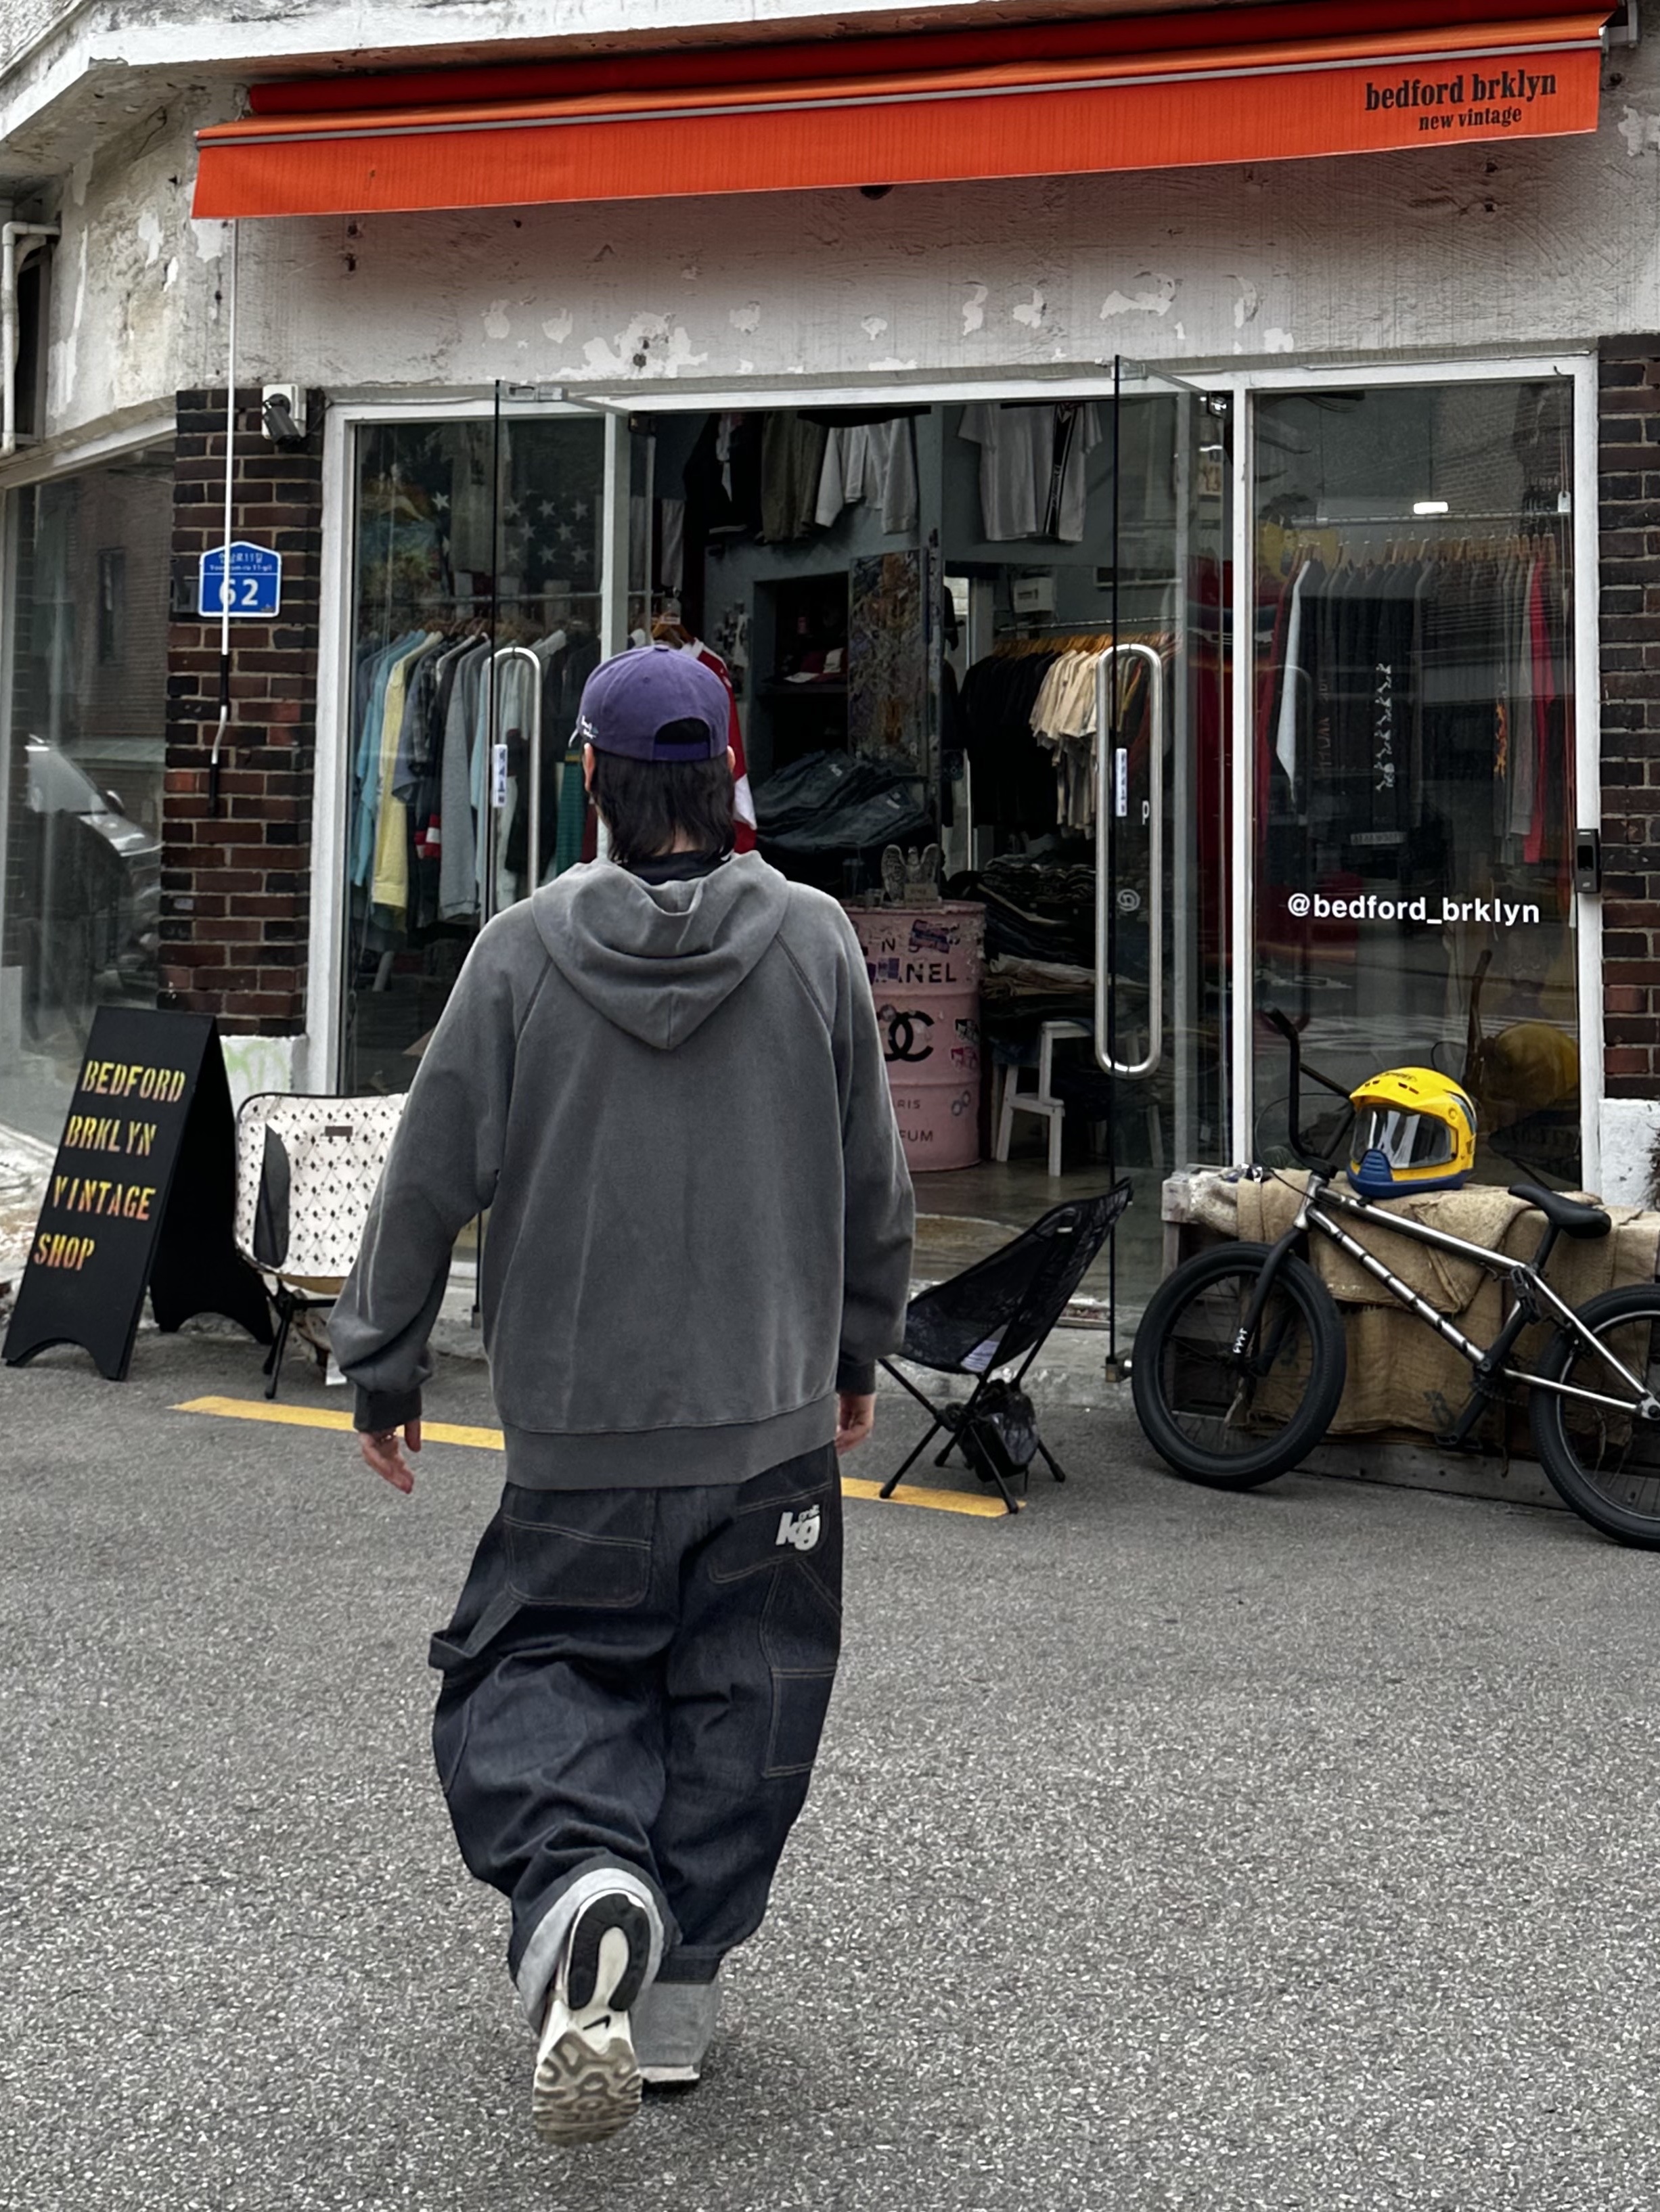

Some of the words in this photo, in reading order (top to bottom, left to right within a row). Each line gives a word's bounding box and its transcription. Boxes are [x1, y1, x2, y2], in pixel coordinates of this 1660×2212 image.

[1365, 75, 1464, 111] bedford
[1472, 69, 1556, 102] brklyn
[1418, 112, 1454, 131] new
[1458, 106, 1522, 127] vintage
[219, 579, 259, 606] 62
[1288, 893, 1540, 926] @bedford_brklyn
[81, 1060, 185, 1102] BEDFORD
[51, 1175, 156, 1221] VINTAGE
[34, 1234, 95, 1271] SHOP
